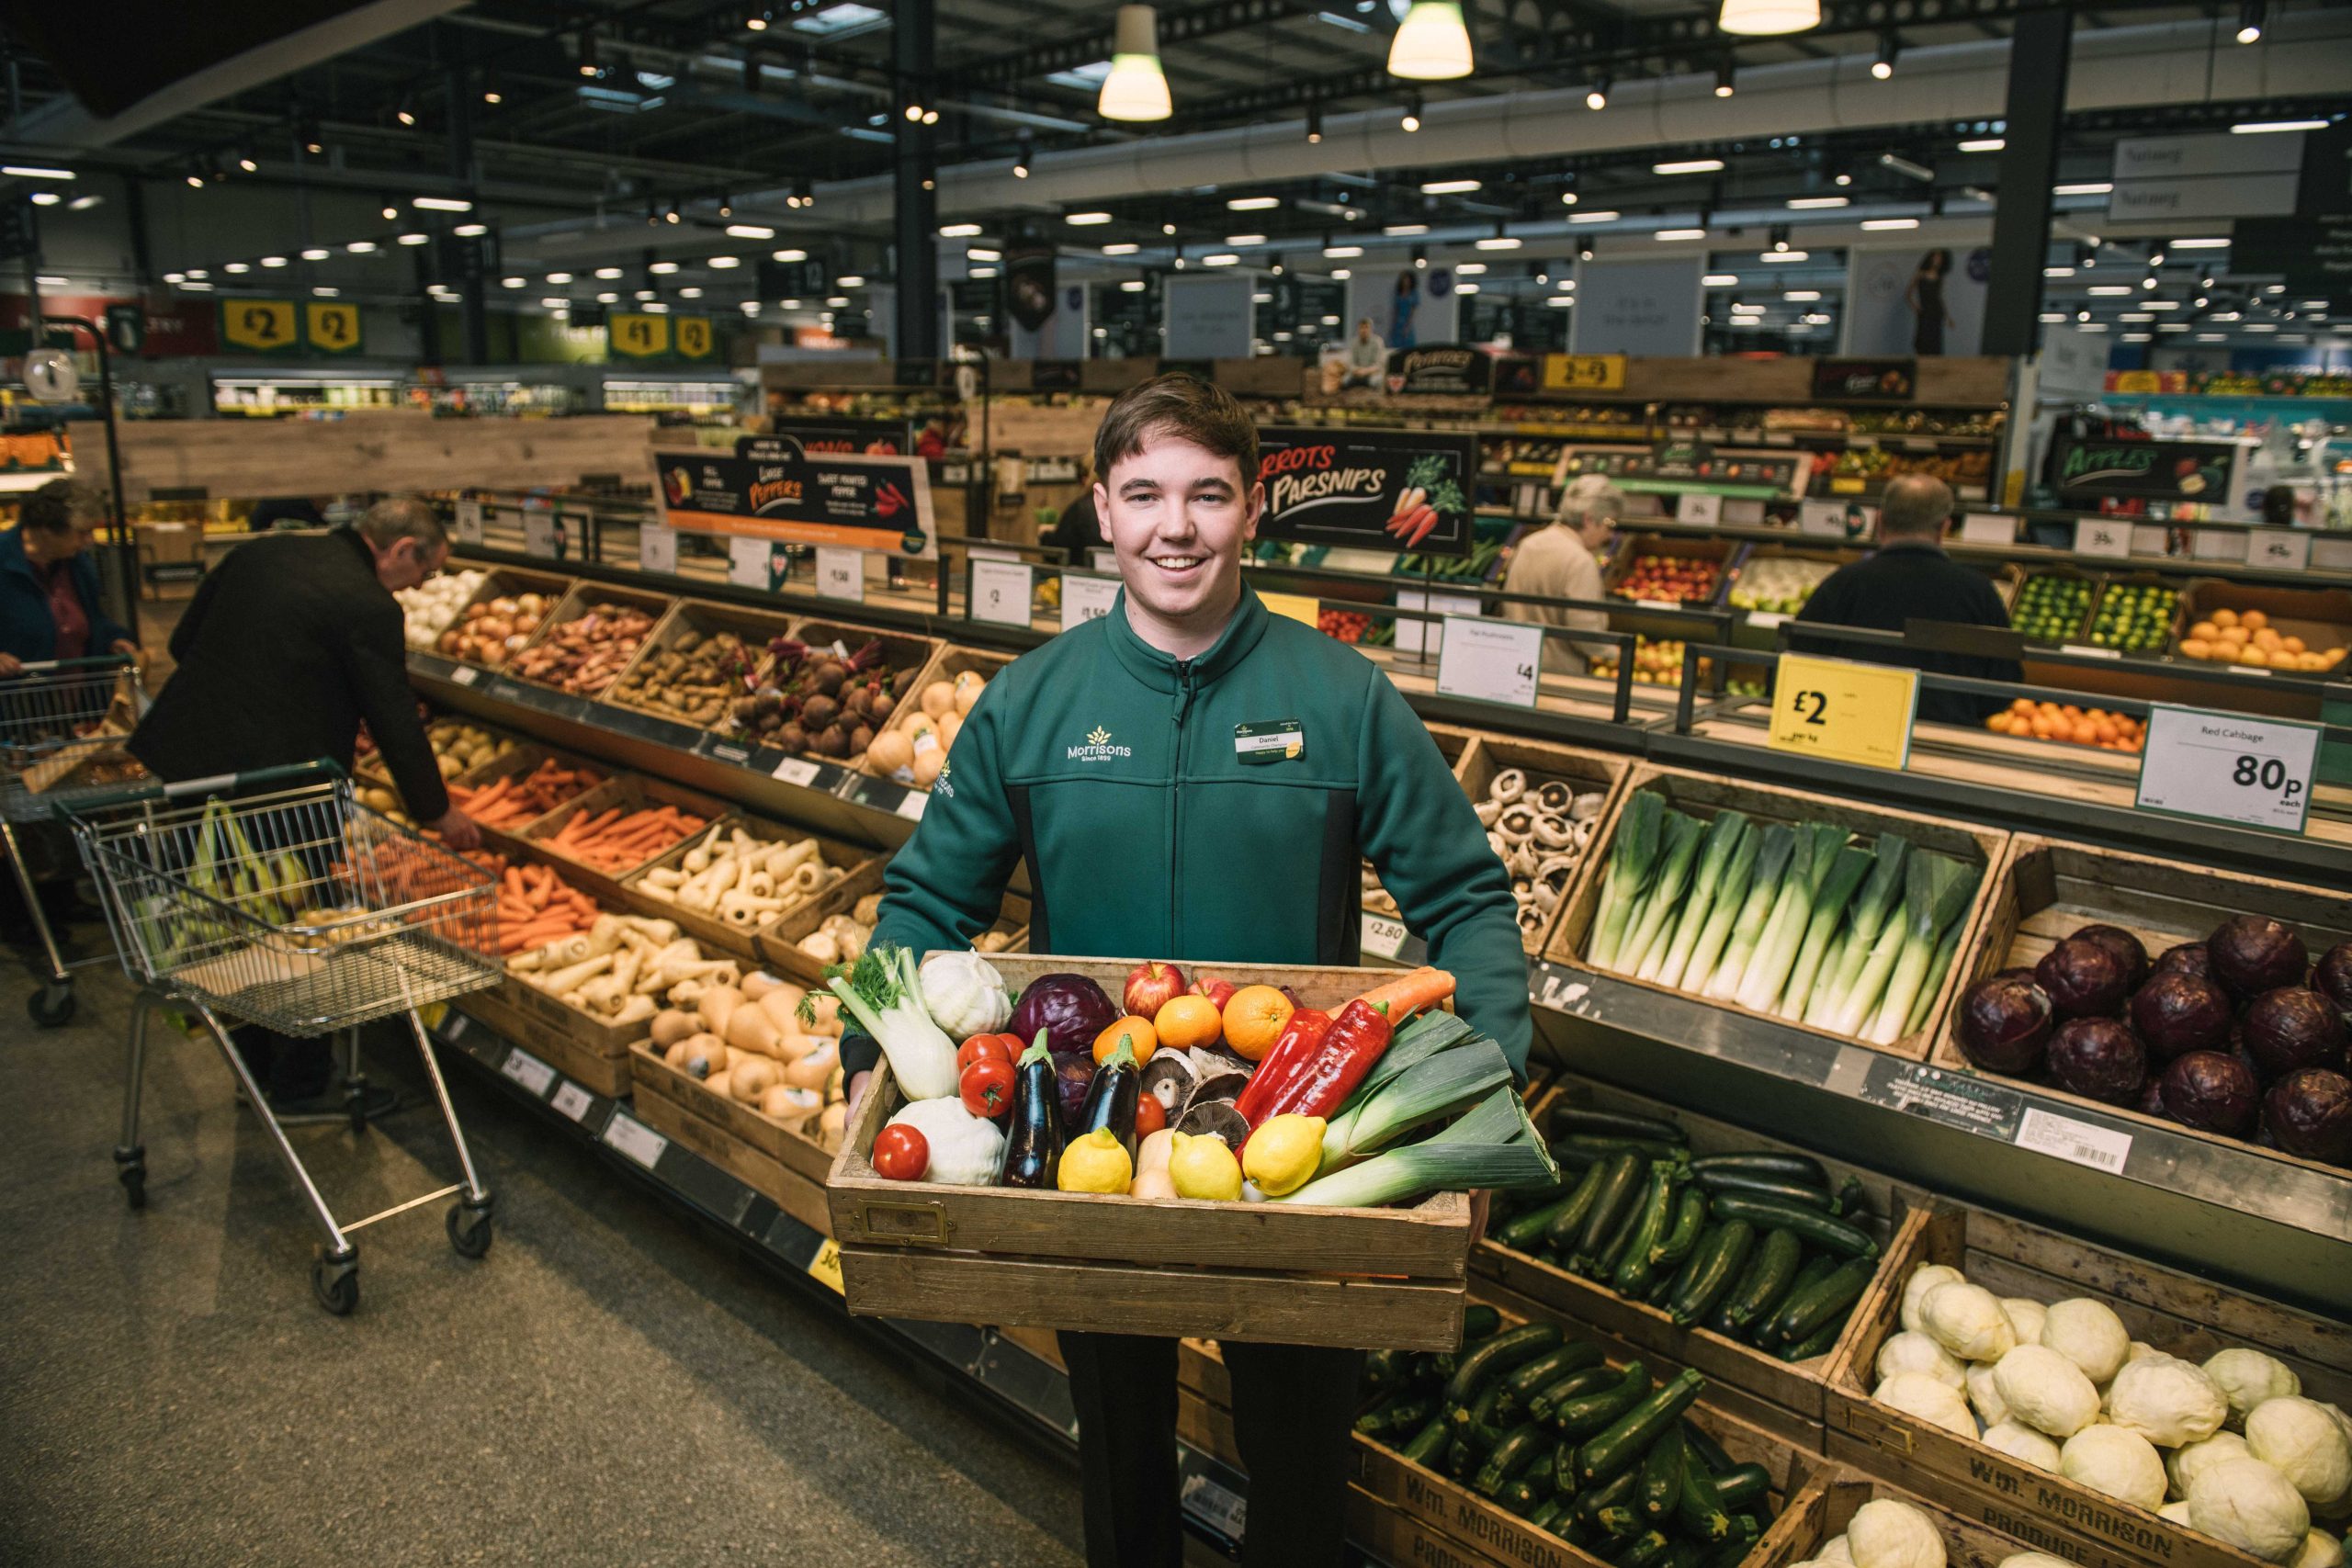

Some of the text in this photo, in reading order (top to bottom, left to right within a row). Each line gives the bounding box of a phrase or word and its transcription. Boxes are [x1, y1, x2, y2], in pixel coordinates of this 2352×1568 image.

[1256, 445, 1336, 481] RROTS
[749, 479, 804, 512] PEPPERS
[1272, 467, 1386, 514] PARSNIPS
[1517, 662, 1533, 681] £4
[1793, 690, 1828, 726] £2
[1068, 742, 1131, 760] Morrisons
[2201, 726, 2264, 743] Red Cabbage
[2233, 755, 2302, 799] 80p
[2279, 799, 2301, 807] each
[1457, 1503, 1562, 1568] MORRISON
[2037, 1486, 2175, 1559] MORRISON
